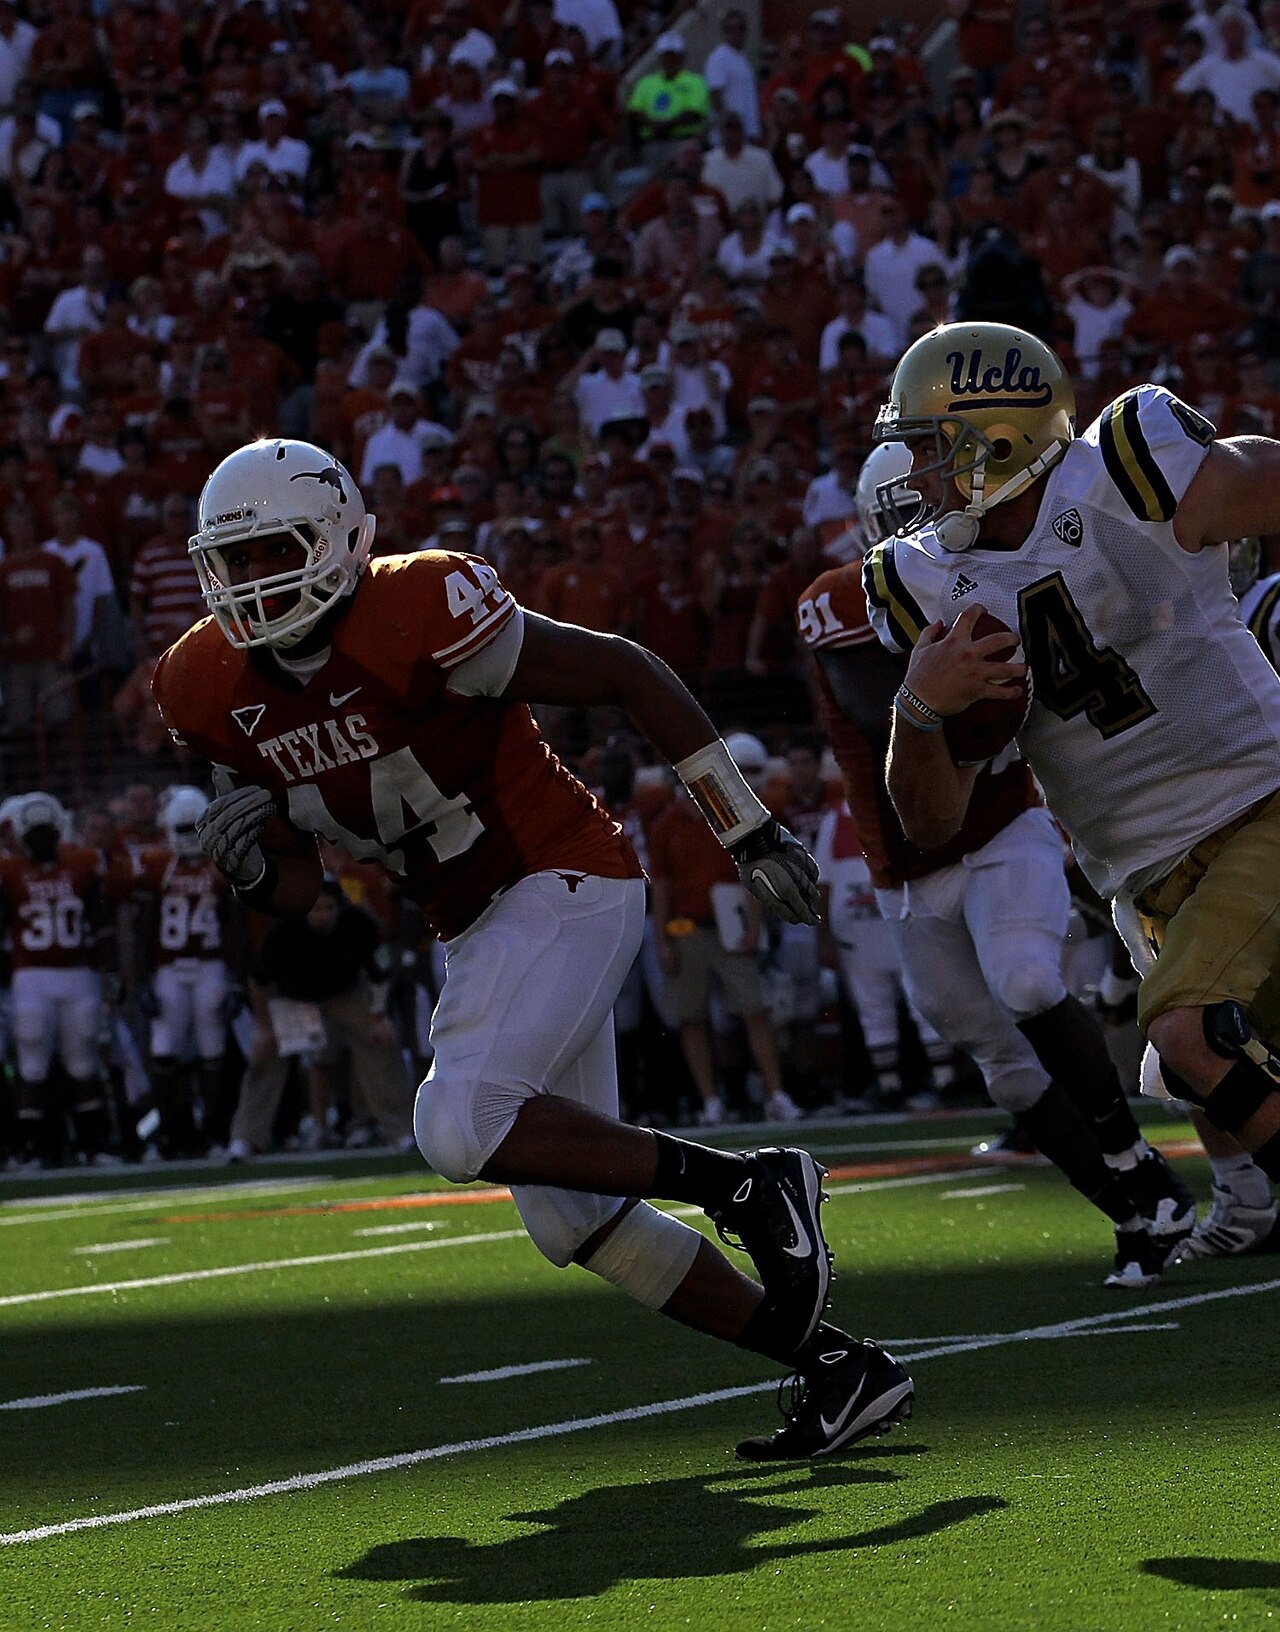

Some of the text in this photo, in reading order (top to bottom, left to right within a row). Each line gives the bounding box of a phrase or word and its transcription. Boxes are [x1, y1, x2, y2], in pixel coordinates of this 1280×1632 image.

[946, 348, 1053, 411] Ucla
[217, 510, 242, 525] HORNS
[444, 565, 508, 626] 44
[798, 592, 845, 644] 91
[951, 581, 979, 601] adidas
[1016, 569, 1159, 741] 4
[256, 713, 380, 782] TEXAS
[17, 897, 84, 952] 30
[159, 897, 223, 951] 84
